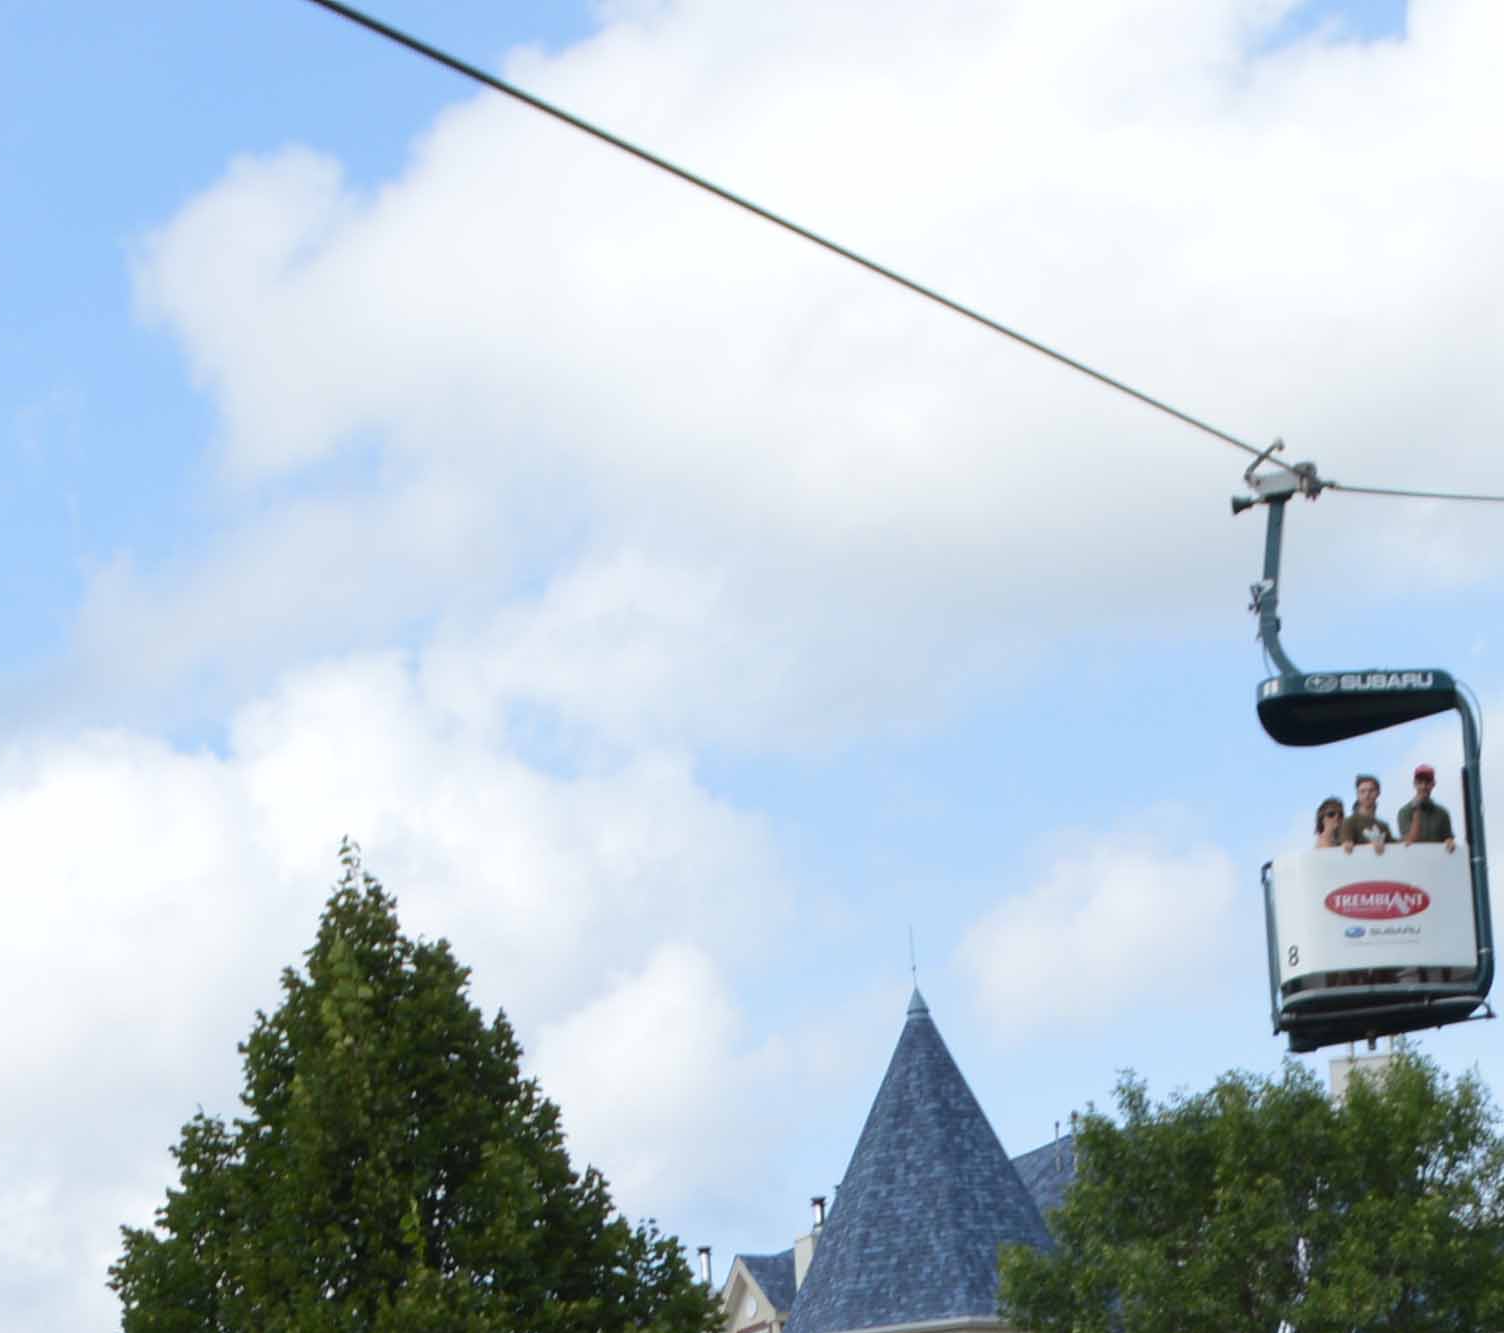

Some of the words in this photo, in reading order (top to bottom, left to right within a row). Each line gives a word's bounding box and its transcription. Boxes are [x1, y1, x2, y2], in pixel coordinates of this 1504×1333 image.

[1340, 671, 1434, 690] SUBARU
[1332, 891, 1424, 911] TREMBLANT
[1369, 925, 1422, 937] SUBARU
[1288, 945, 1299, 967] 8
